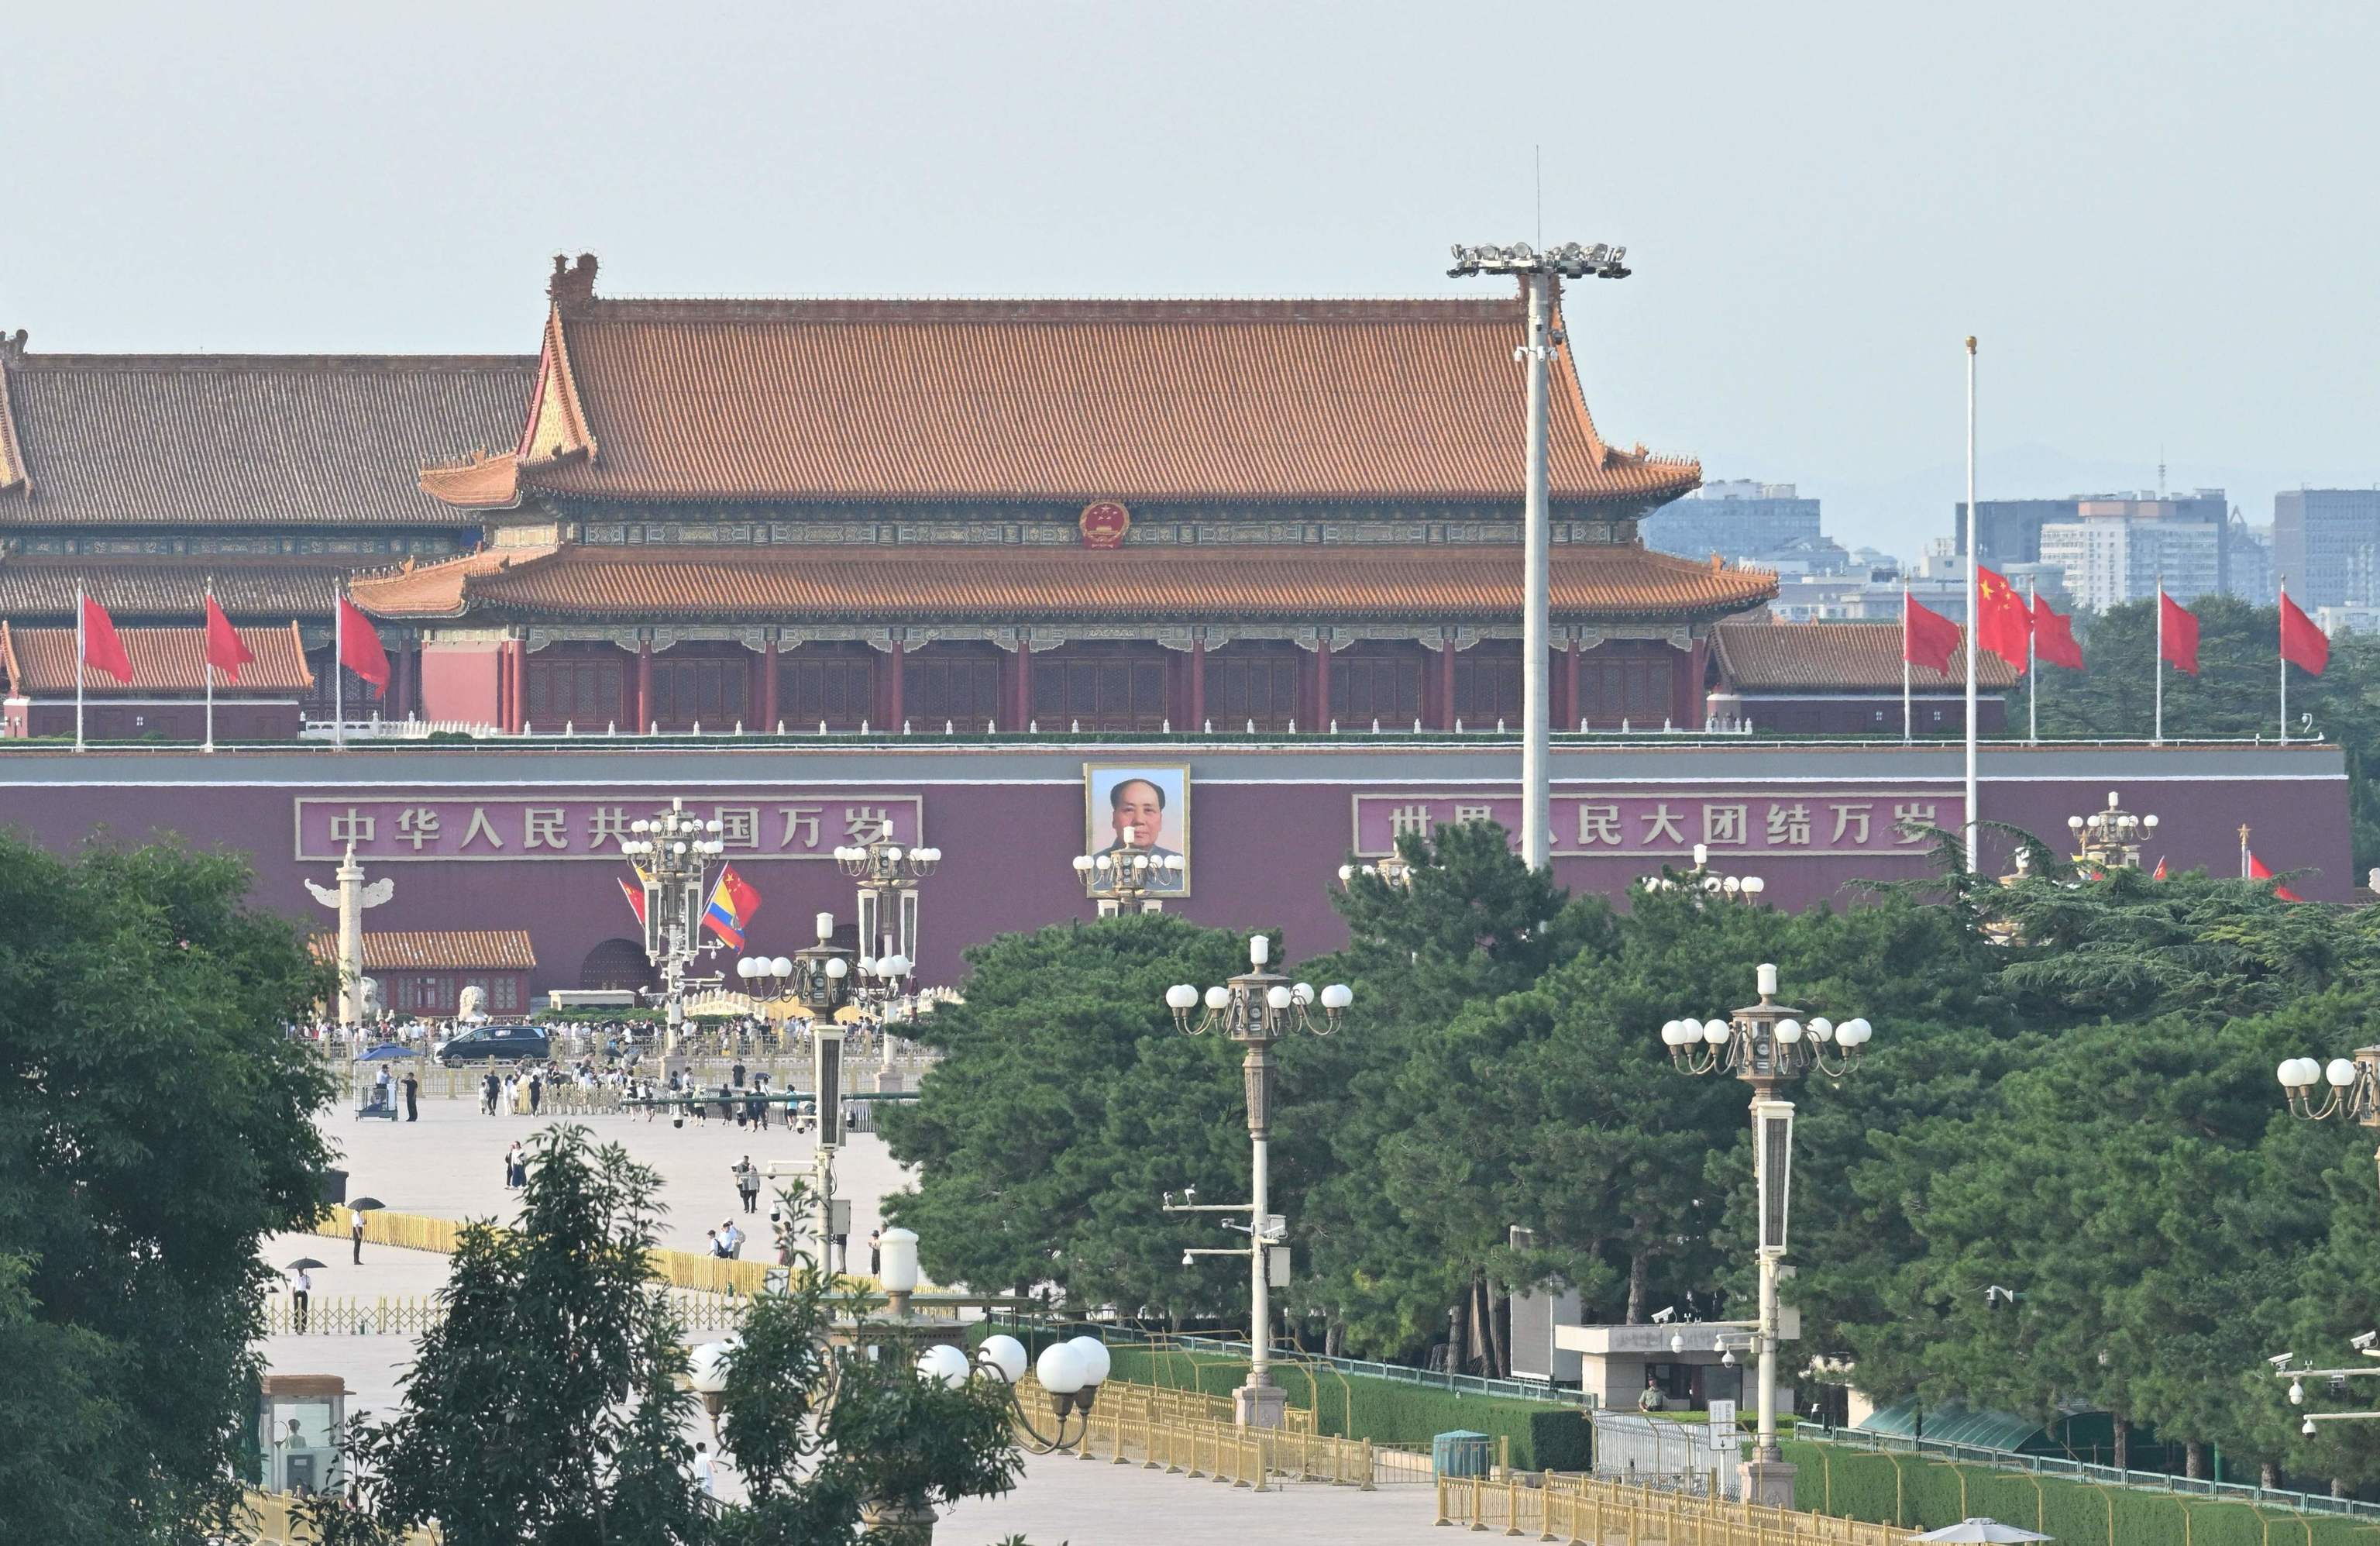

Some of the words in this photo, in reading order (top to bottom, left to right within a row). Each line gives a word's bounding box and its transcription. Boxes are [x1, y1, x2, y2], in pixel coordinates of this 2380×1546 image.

[329, 807, 887, 850] 中华人民共国万岁
[1388, 804, 1936, 845] 世民大团结万岁
